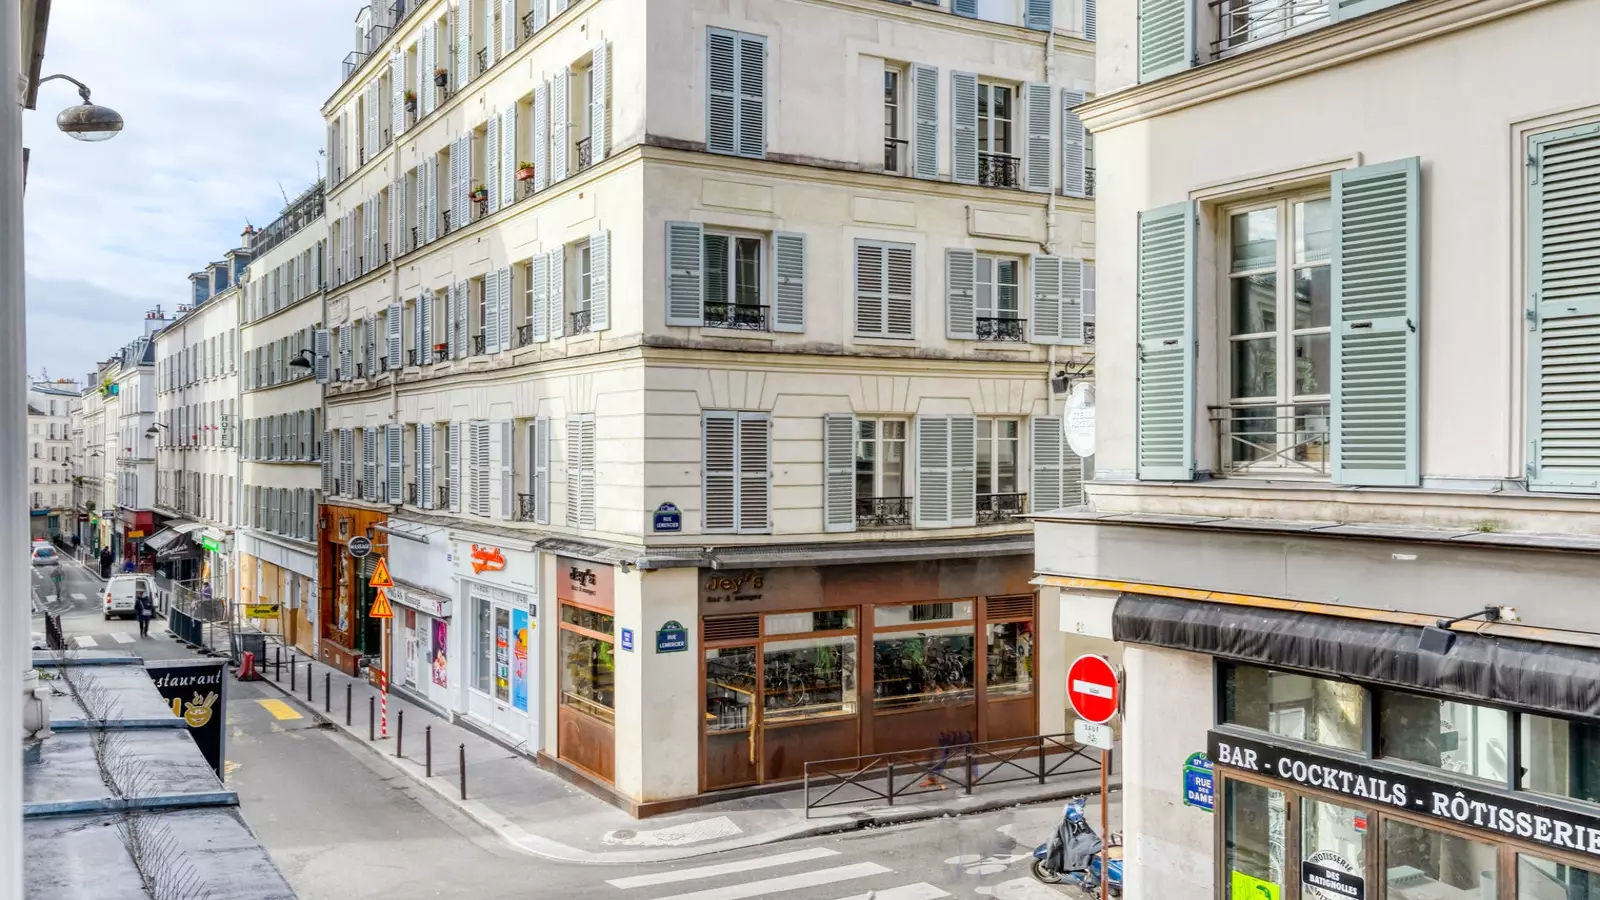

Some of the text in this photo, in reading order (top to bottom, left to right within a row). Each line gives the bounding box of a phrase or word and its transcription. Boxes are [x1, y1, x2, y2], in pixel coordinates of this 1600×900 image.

[705, 573, 764, 594] Jey's
[659, 641, 685, 649] LEMERCIER
[1195, 776, 1212, 788] RUE
[1198, 786, 1209, 794] DES
[1218, 742, 1259, 771] BAR
[1278, 757, 1407, 807] COCKTAILS
[1431, 791, 1600, 855] RÔTISSERIE
[1325, 870, 1340, 881] DES
[1309, 873, 1357, 896] BATIGNOLLES
